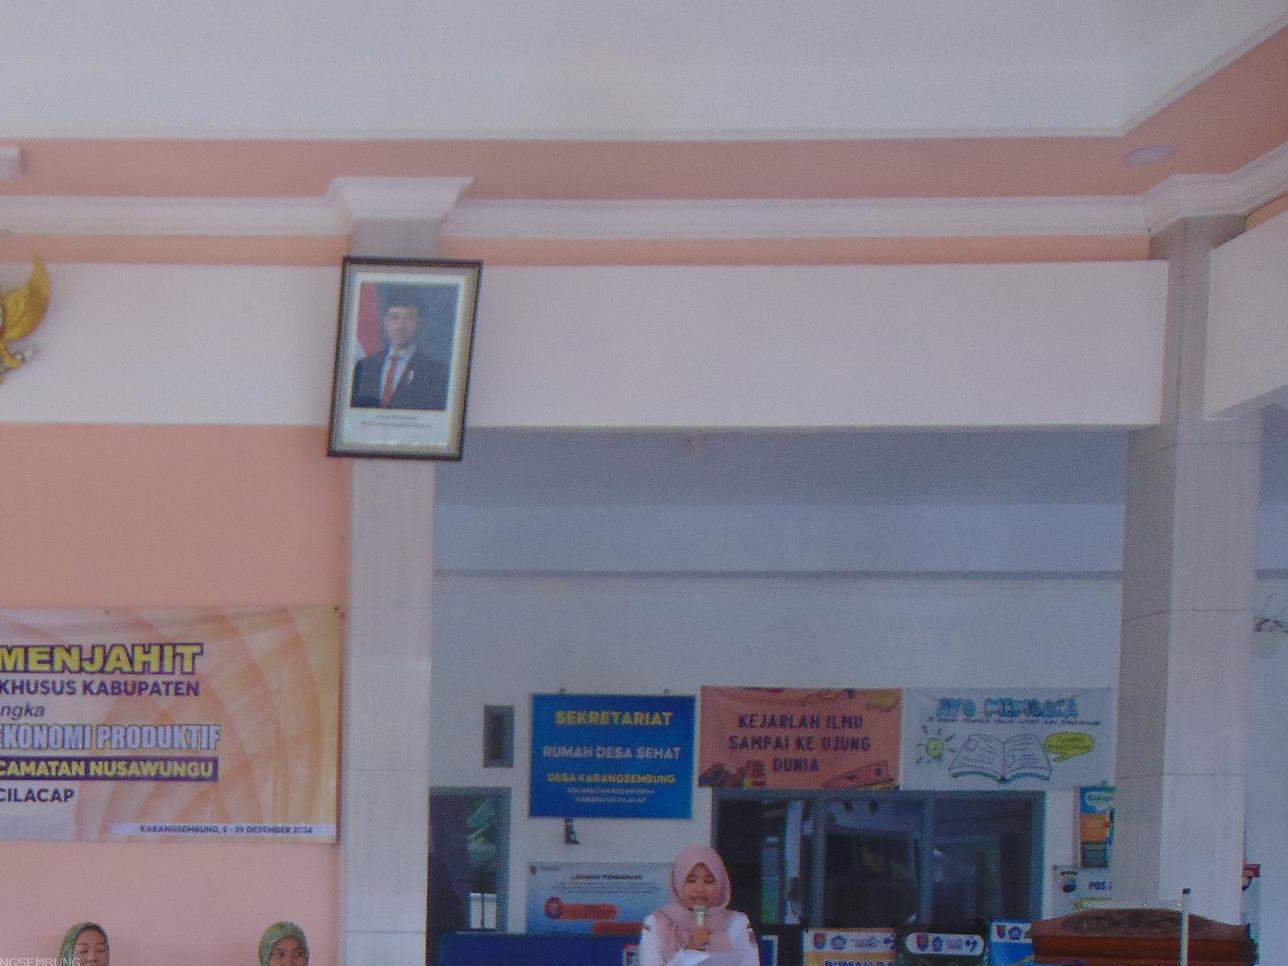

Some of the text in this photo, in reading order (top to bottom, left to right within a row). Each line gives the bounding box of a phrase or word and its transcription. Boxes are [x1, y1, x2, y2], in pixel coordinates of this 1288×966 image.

[83, 680, 200, 697] KABUPATEN
[556, 710, 673, 726] SEKRETARIAT
[737, 713, 864, 729] KEJARLAH ILMU
[96, 724, 221, 750] PRODUKTIF
[729, 735, 872, 751] SAMPAI KE UJUNG
[542, 745, 681, 759] RUMAH DESA SEHAT
[89, 760, 213, 777] NUSAWUNGU
[773, 757, 820, 772] DUNIA
[579, 773, 675, 784] KARANGSEMBUNG
